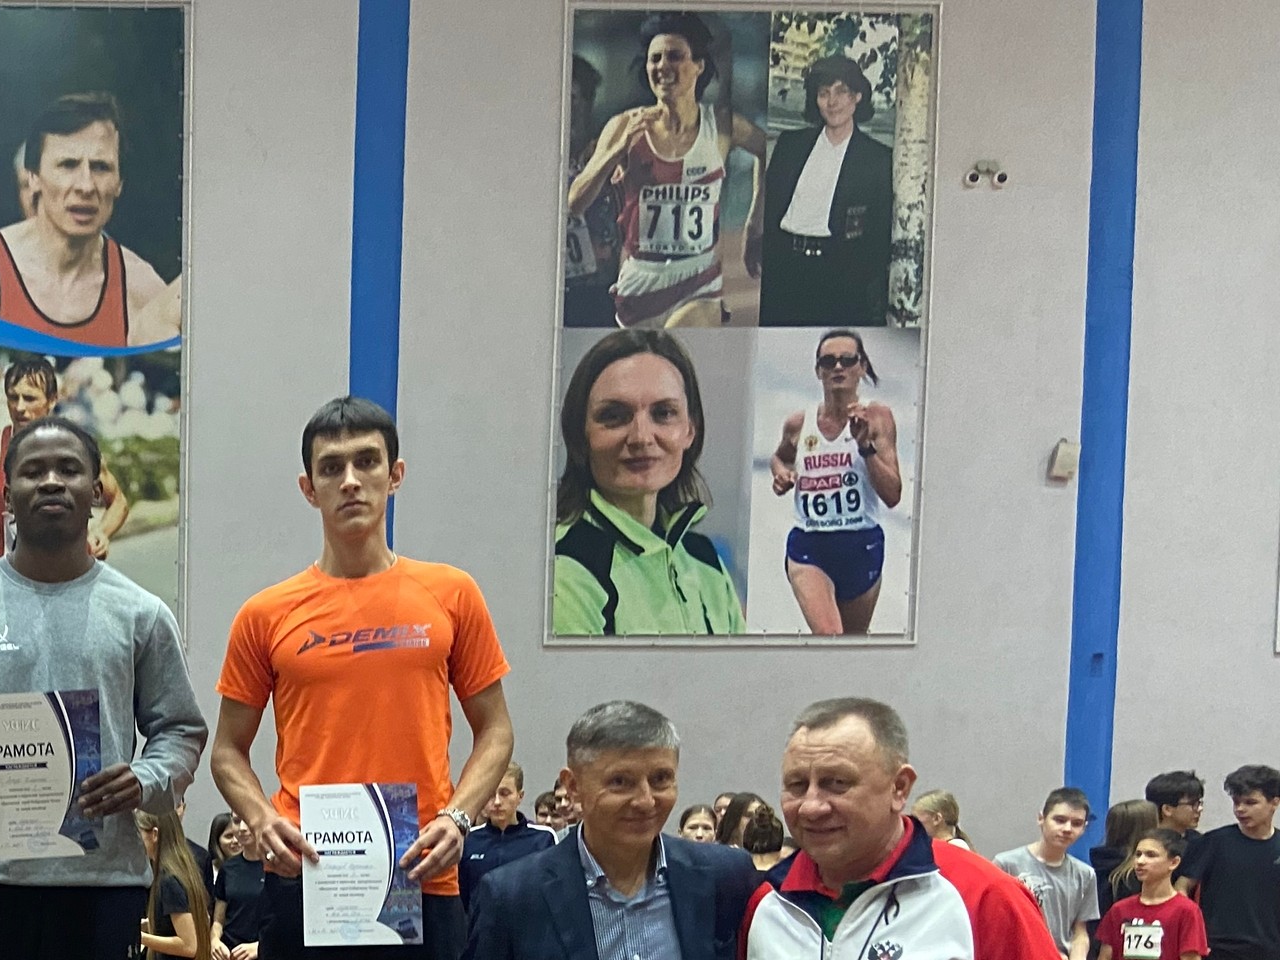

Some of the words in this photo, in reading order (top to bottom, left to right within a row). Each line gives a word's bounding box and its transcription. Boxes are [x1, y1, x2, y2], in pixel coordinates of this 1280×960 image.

[642, 186, 710, 200] PHILIPS
[646, 204, 704, 241] 713
[804, 453, 853, 471] RUSSIA
[801, 476, 841, 490] SPAR
[801, 488, 860, 517] 1619
[306, 830, 373, 844] ГРАМОТА
[1127, 934, 1154, 949] 176
